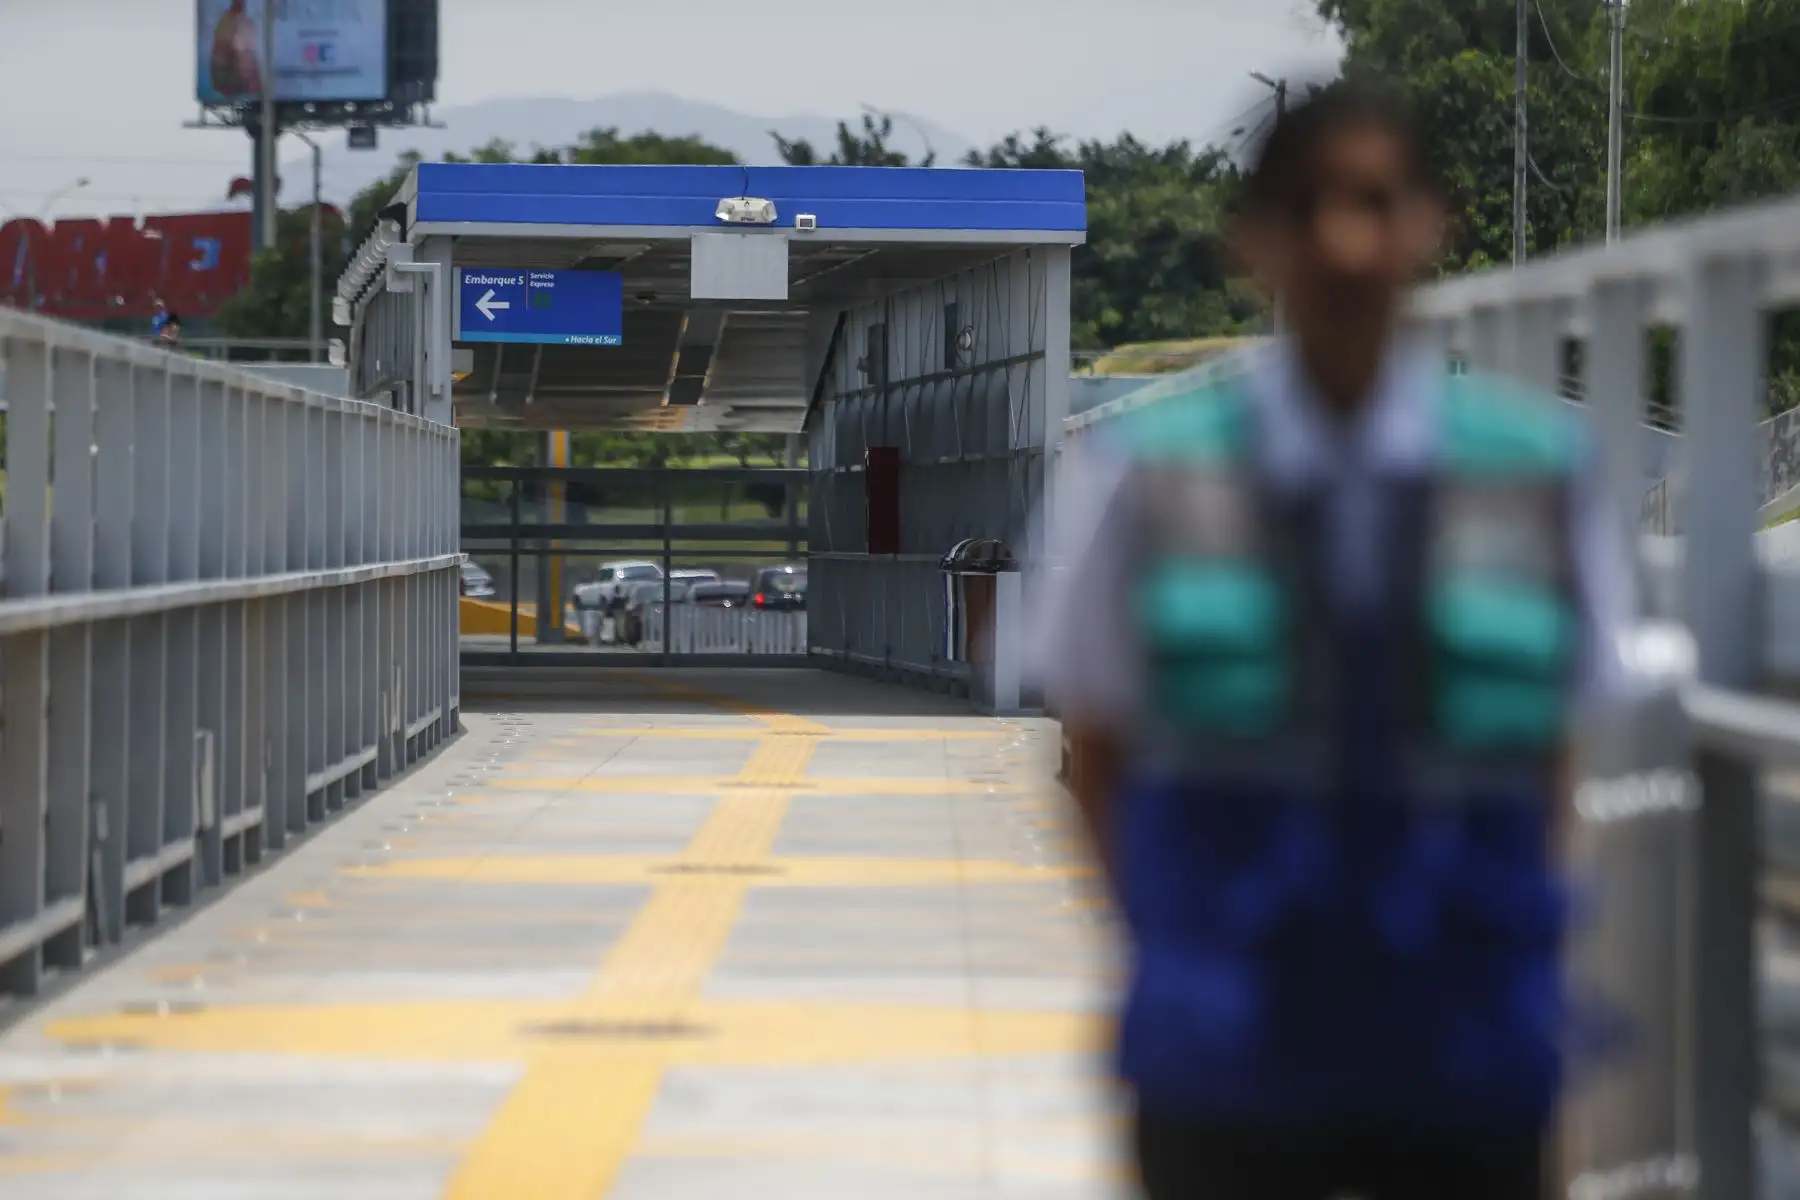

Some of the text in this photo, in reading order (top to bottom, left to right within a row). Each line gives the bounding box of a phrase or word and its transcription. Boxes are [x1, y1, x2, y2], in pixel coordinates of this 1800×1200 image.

[464, 275, 516, 287] Embarque
[530, 280, 555, 288] Expreso
[571, 336, 617, 344] Hacia el Sur
